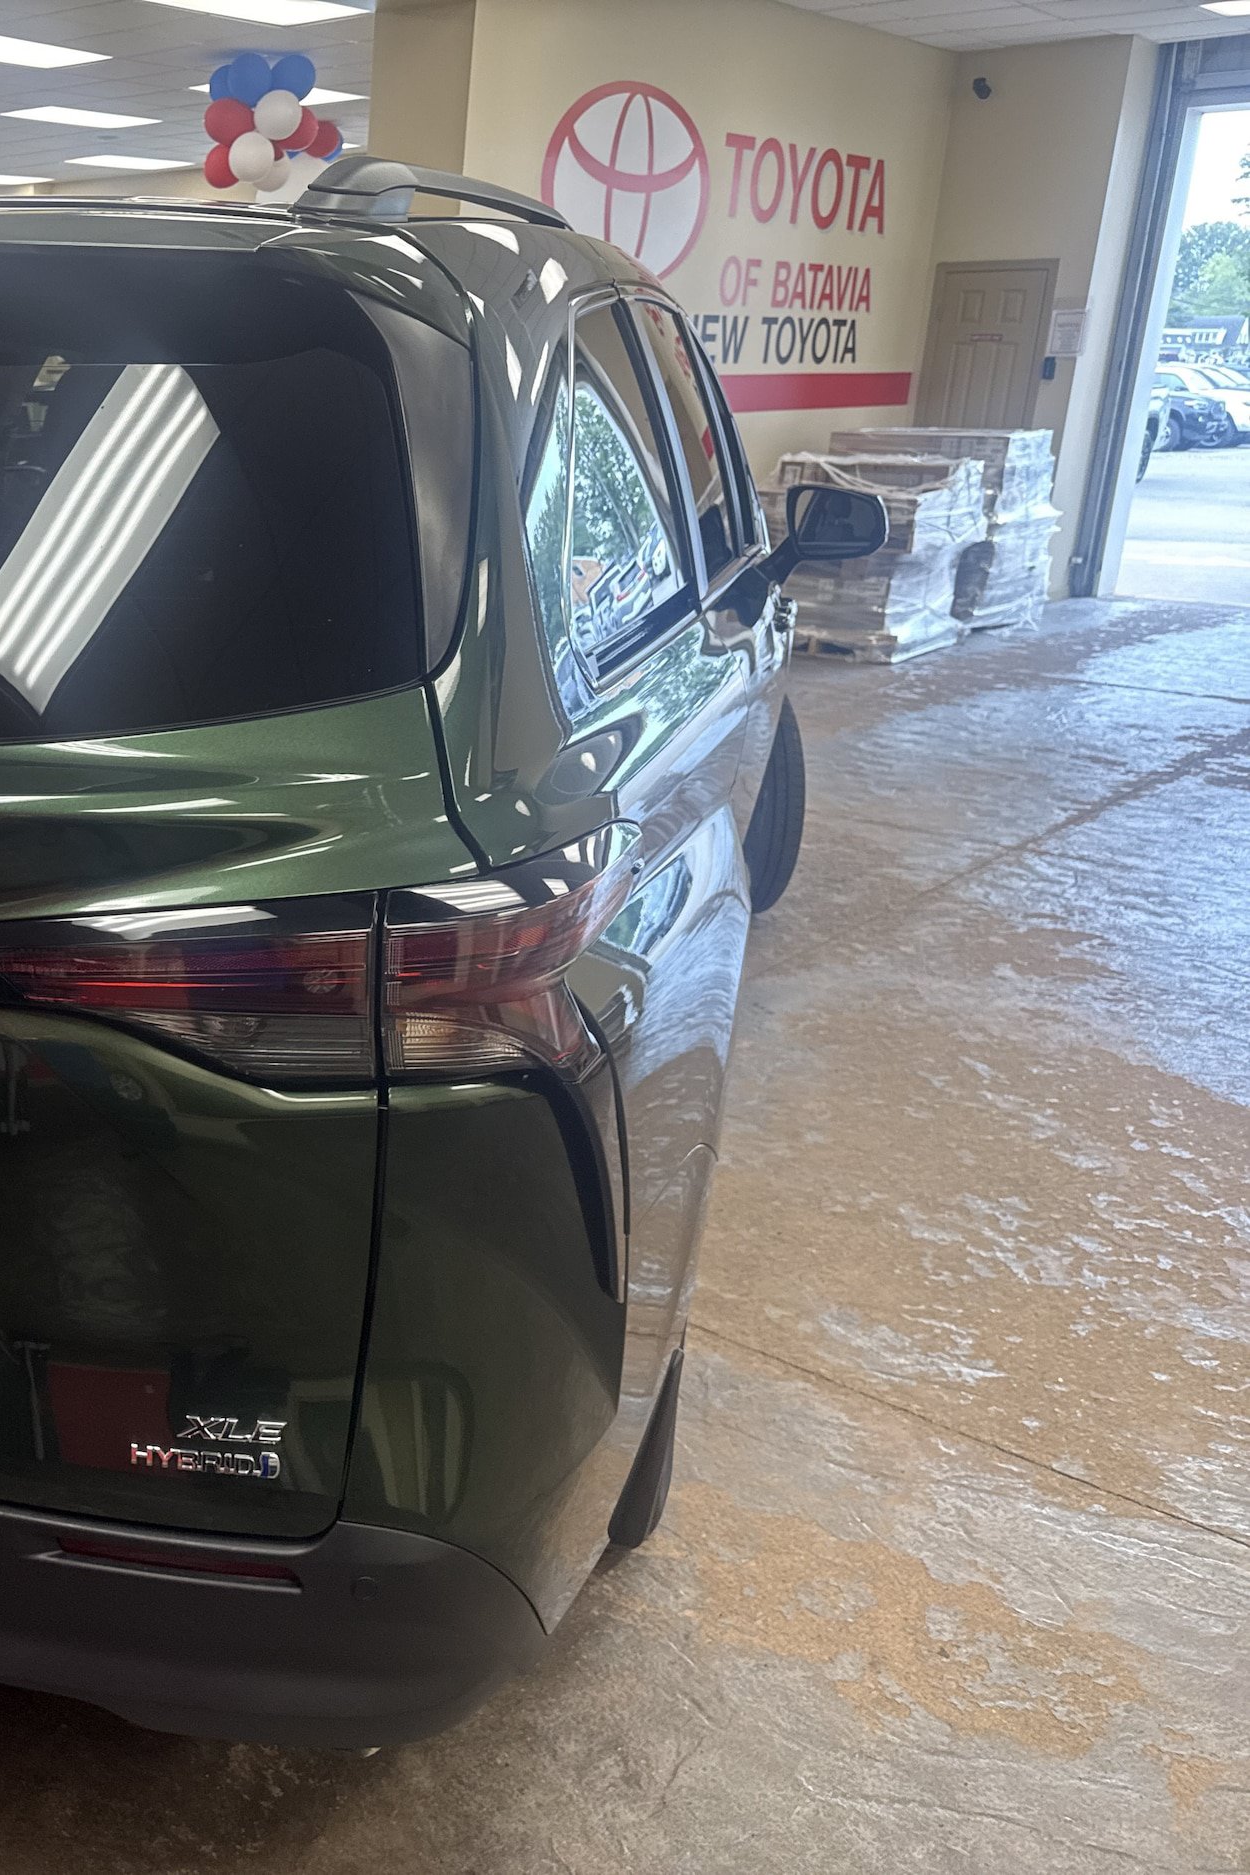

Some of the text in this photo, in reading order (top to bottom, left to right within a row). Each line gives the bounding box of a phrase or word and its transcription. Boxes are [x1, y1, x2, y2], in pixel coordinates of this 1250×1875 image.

[724, 132, 885, 235] TOYOTA
[719, 255, 871, 313] OF BATAVIA
[693, 314, 750, 365] EW
[761, 315, 857, 366] TOYOTA
[176, 1414, 288, 1445] XLE
[130, 1442, 255, 1476] HYBRID
